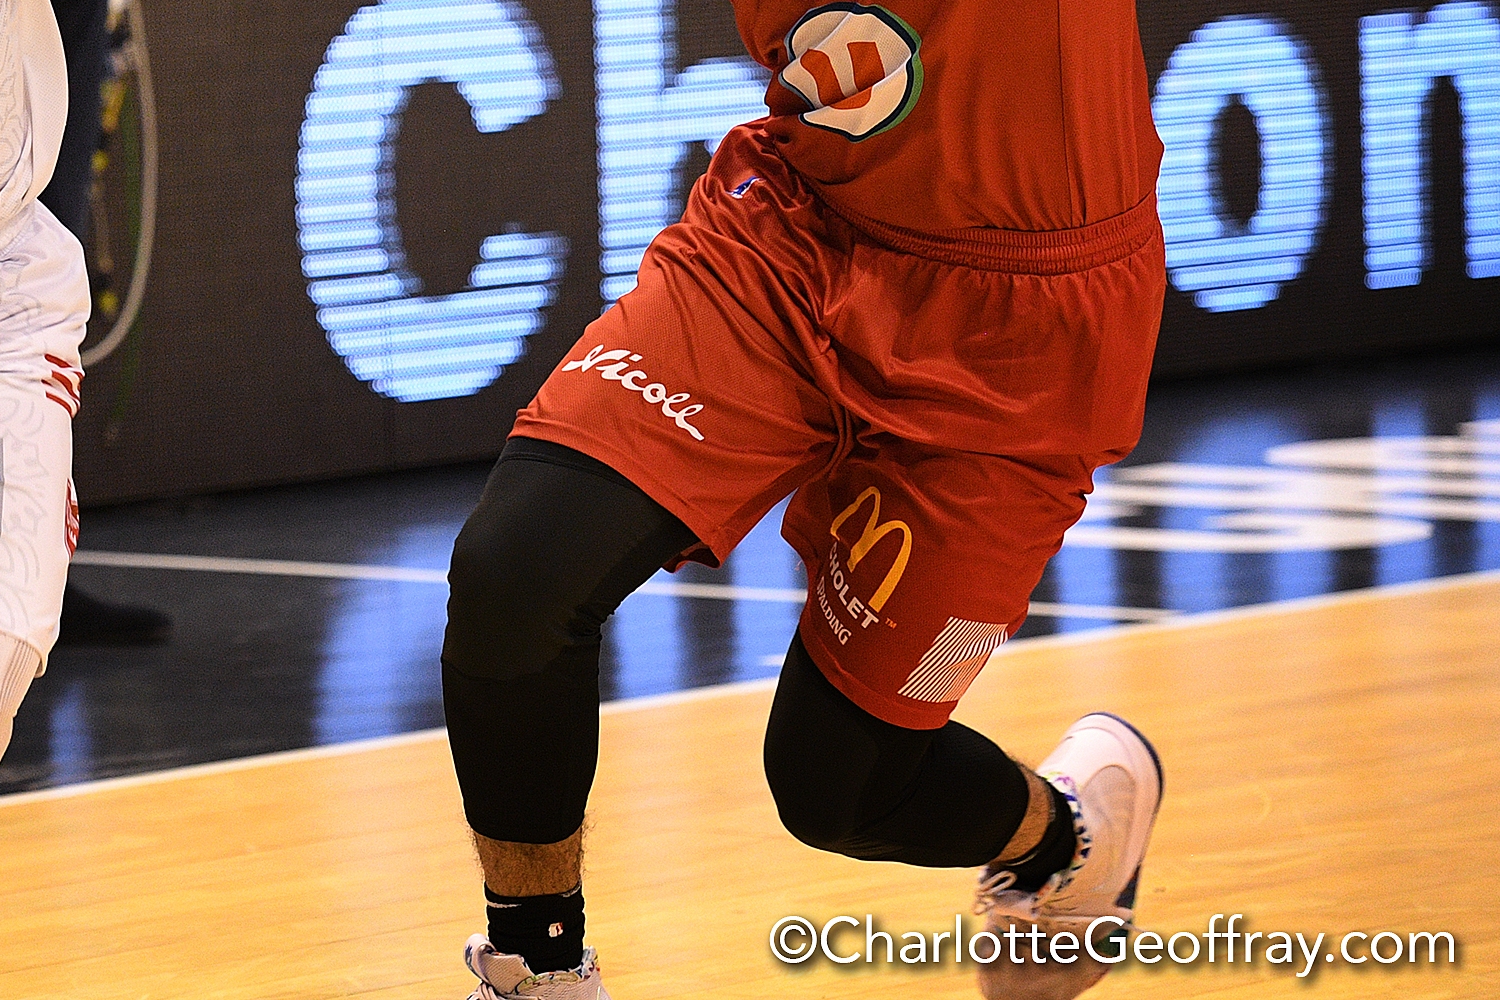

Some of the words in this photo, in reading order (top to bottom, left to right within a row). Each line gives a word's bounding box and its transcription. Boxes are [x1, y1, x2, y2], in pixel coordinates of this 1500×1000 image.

[561, 344, 705, 441] Nicoll
[816, 576, 852, 646] SPALDING
[829, 541, 879, 629] CHOLET
